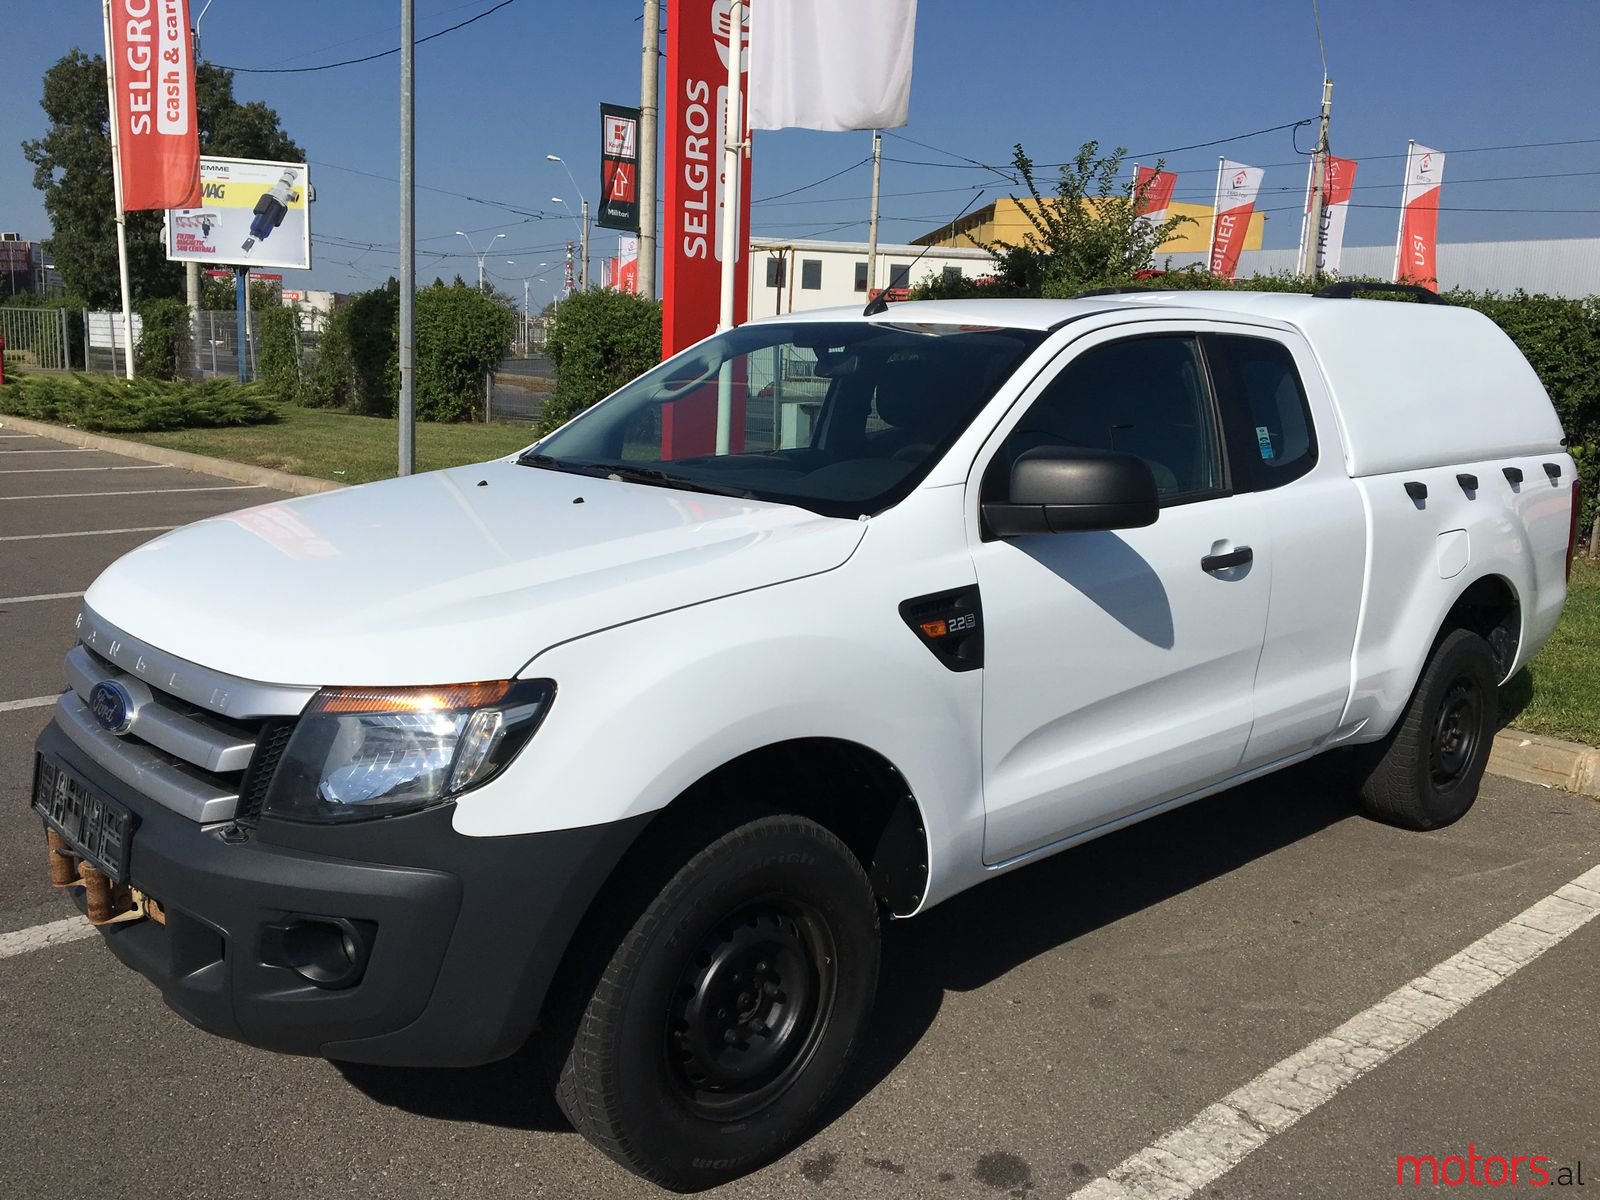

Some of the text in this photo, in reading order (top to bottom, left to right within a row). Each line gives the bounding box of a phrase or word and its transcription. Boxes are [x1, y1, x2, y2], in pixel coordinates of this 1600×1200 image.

[163, 0, 179, 122] cash & car
[683, 78, 710, 260] SELGROS
[93, 687, 118, 723] Ford
